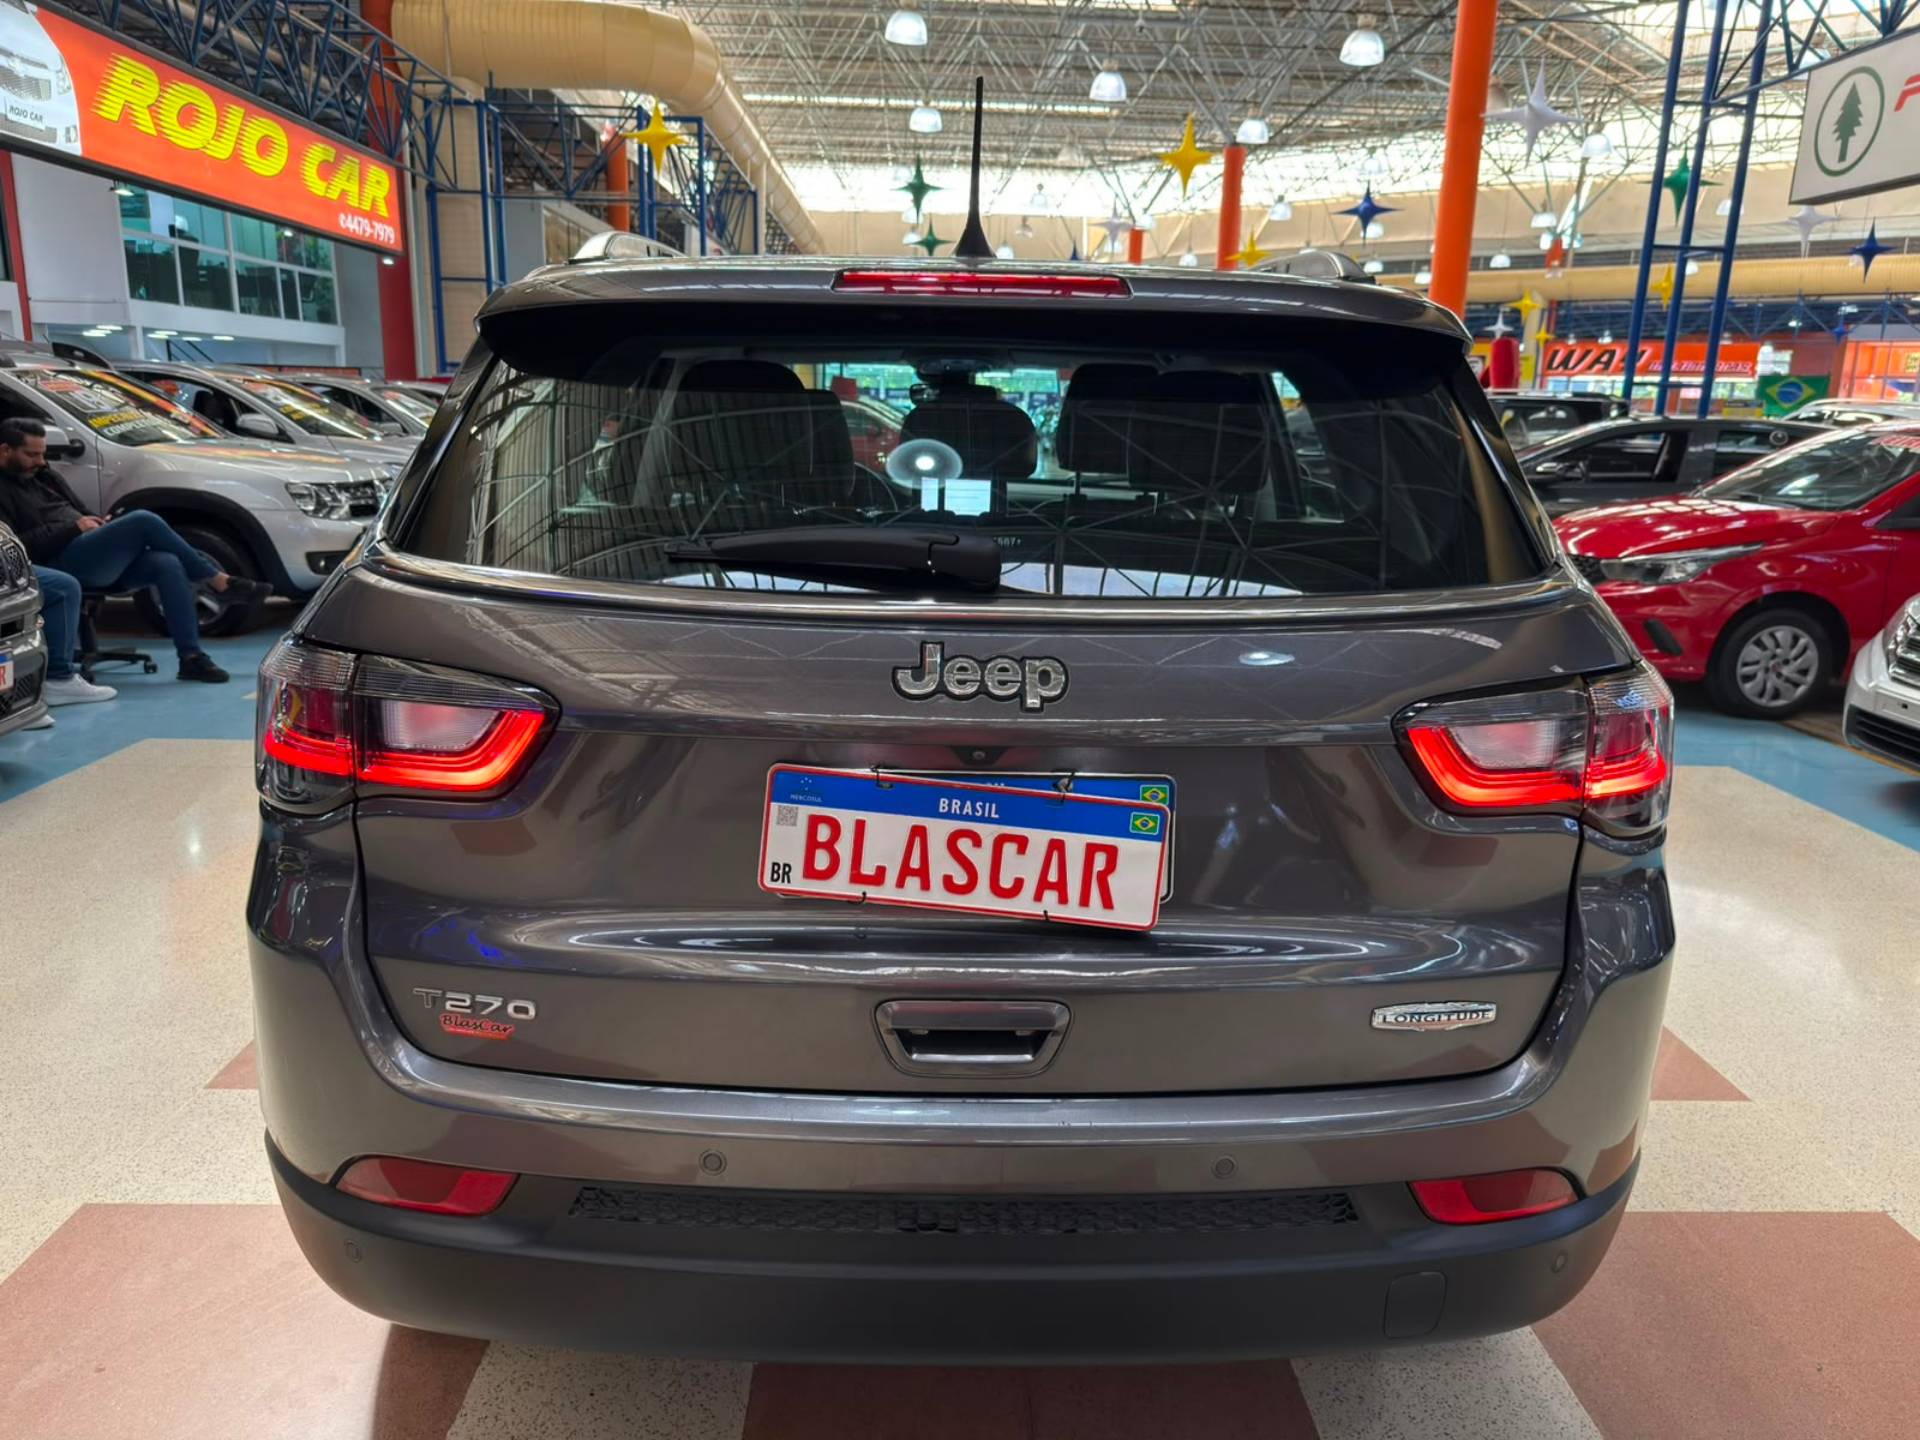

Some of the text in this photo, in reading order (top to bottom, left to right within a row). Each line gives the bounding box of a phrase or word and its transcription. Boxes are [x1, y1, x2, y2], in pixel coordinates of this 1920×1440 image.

[9, 105, 43, 123] ROJO CAR
[91, 52, 391, 218] ROJO CAR
[894, 642, 1068, 711] Jeep
[938, 797, 1000, 819] BRASIL
[769, 861, 792, 884] BR
[802, 813, 1120, 911] BLASCAR
[412, 986, 537, 1020] T270
[1382, 1009, 1491, 1024] LONGITUDE
